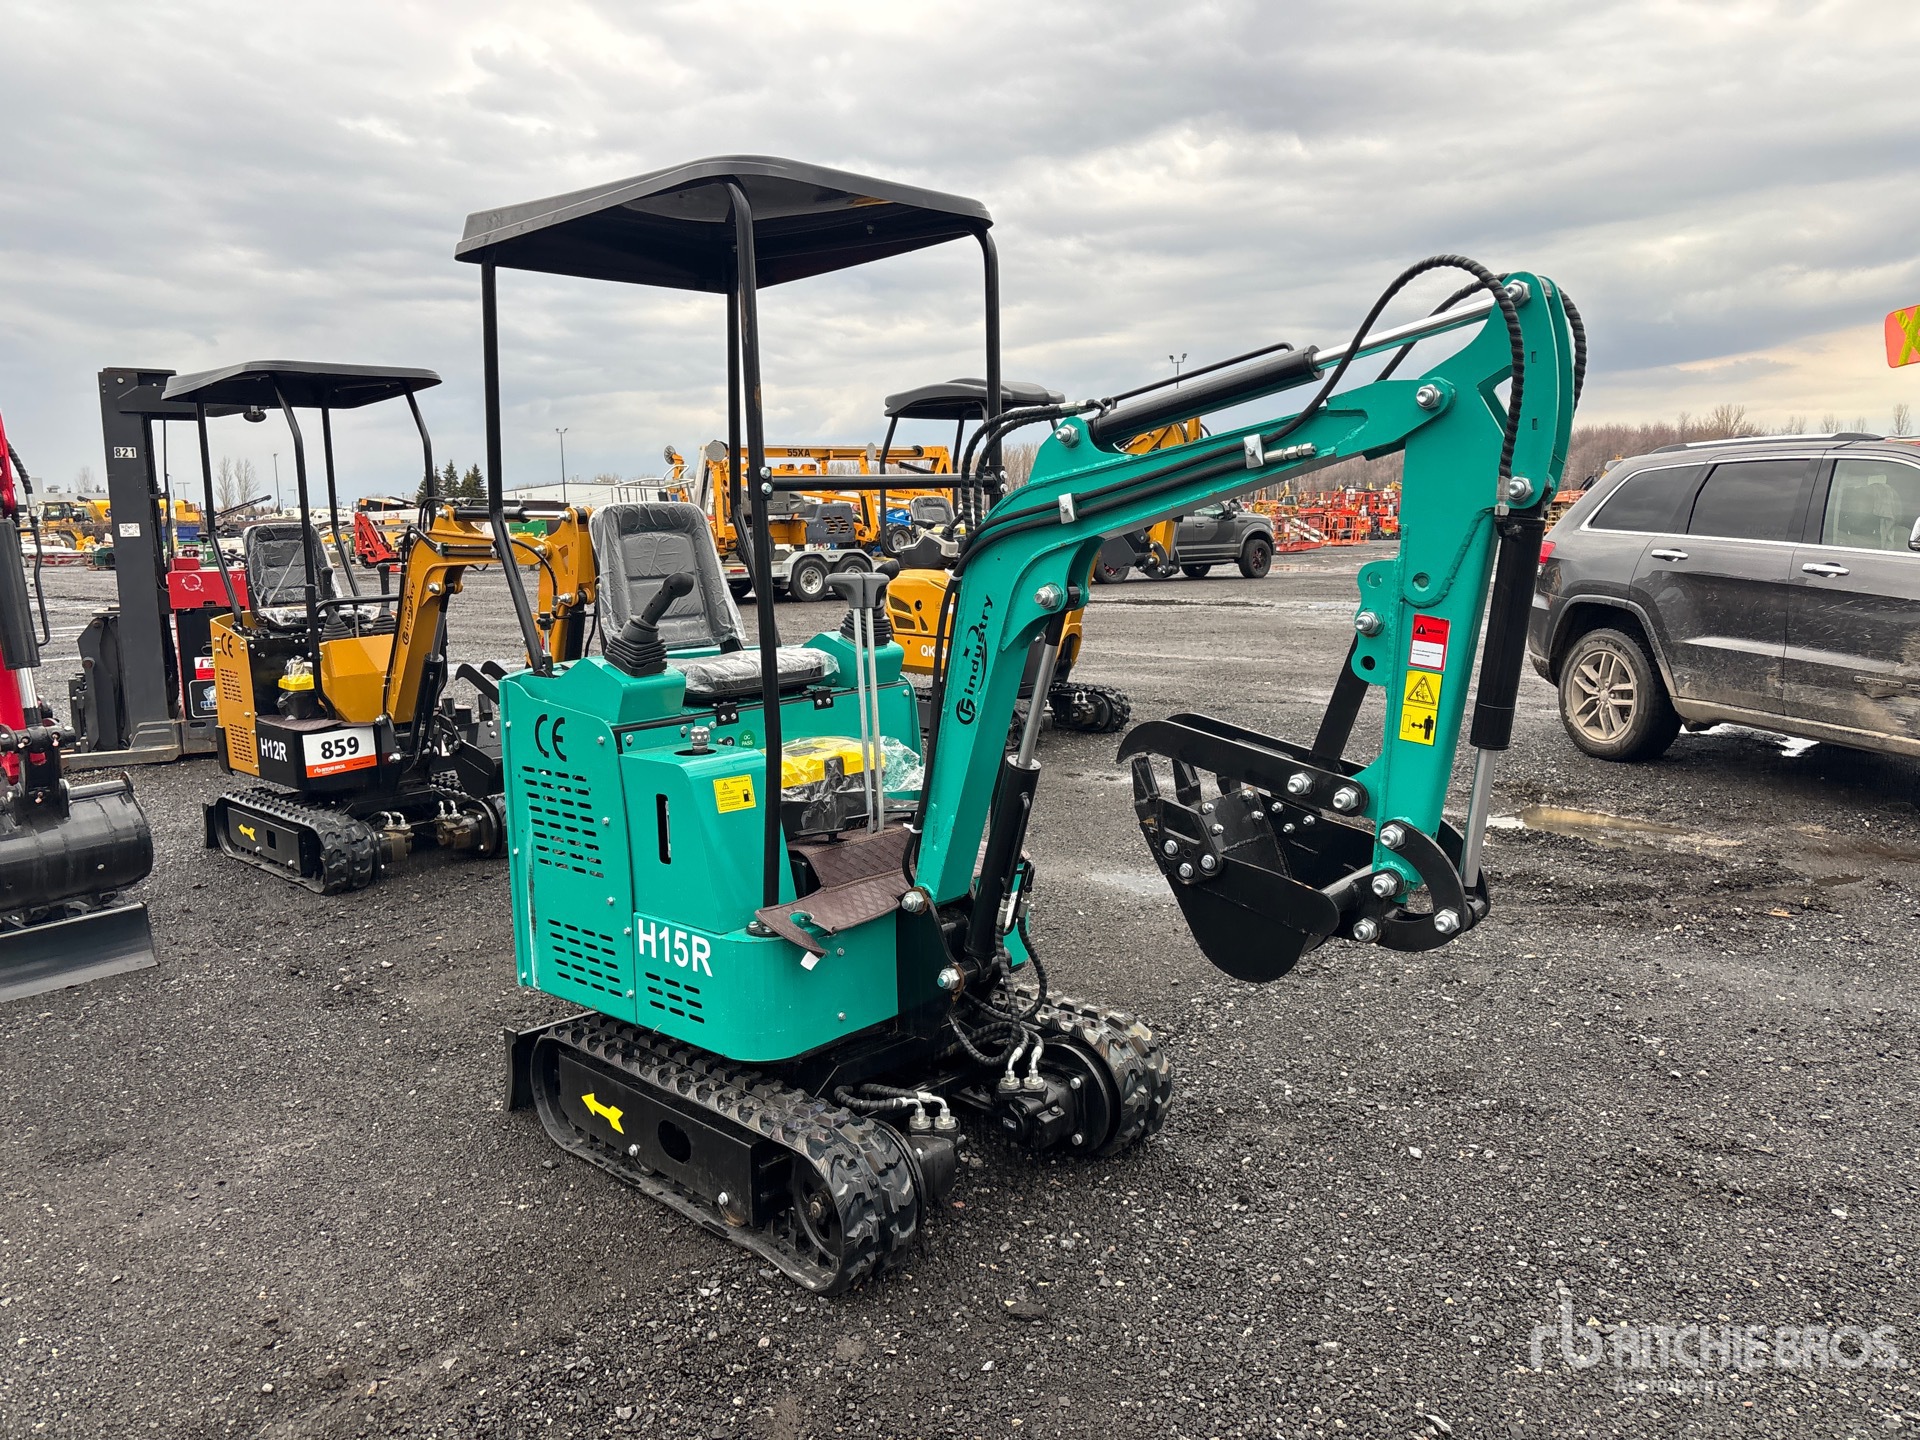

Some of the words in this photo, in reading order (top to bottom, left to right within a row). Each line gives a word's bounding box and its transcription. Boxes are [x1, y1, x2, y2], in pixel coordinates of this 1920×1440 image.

[115, 448, 136, 458] 821
[787, 448, 811, 458] 55XA
[260, 737, 288, 762] H12R
[320, 736, 360, 760] 859
[638, 918, 713, 978] H15R
